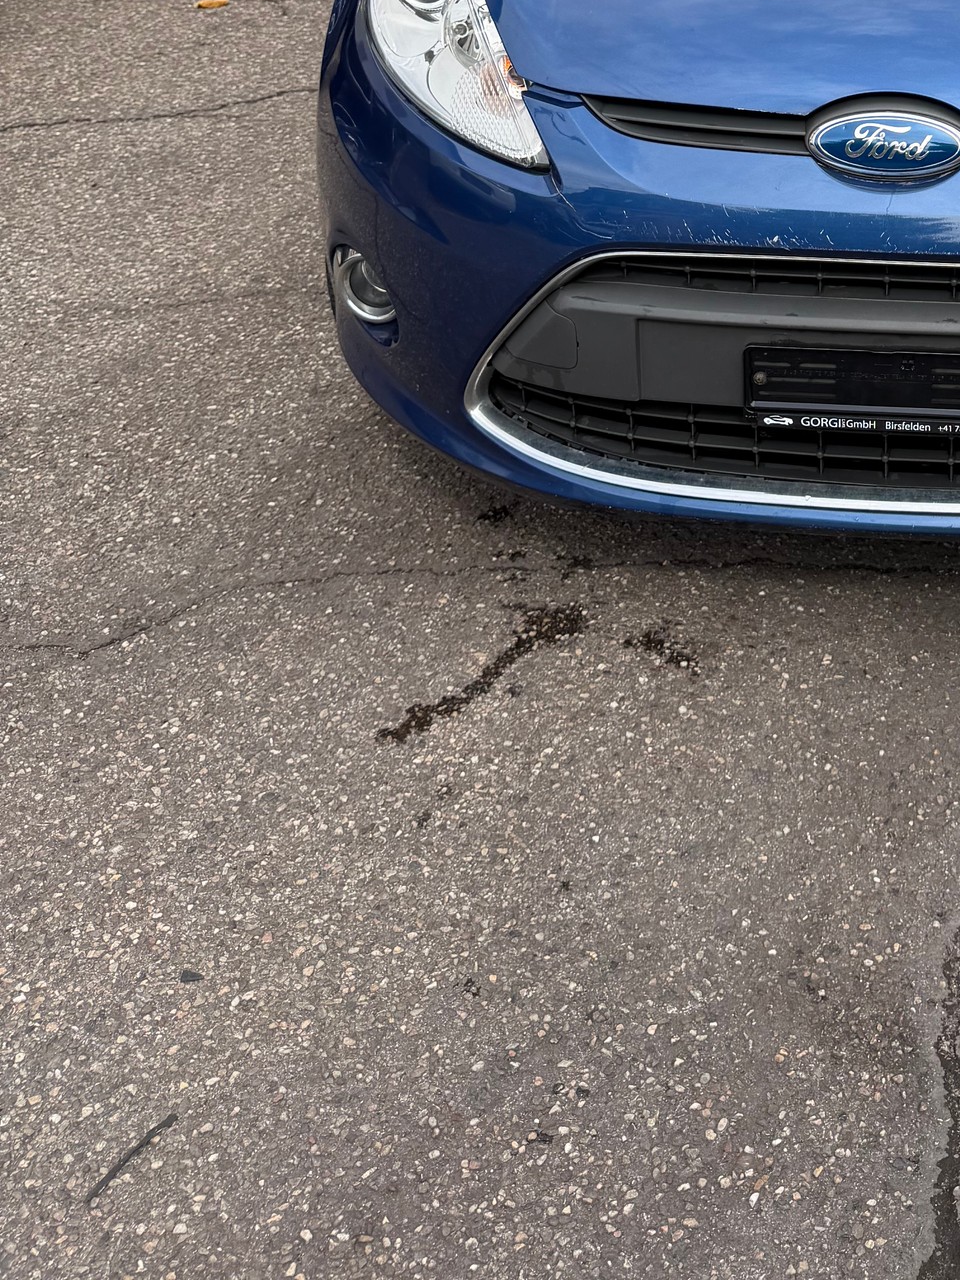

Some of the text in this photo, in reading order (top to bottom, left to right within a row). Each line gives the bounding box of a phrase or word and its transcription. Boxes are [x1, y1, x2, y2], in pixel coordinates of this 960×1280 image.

[845, 123, 933, 160] Ford
[801, 417, 841, 428] GORGI
[846, 420, 876, 429] GmbH
[885, 421, 931, 431] Birsfelden
